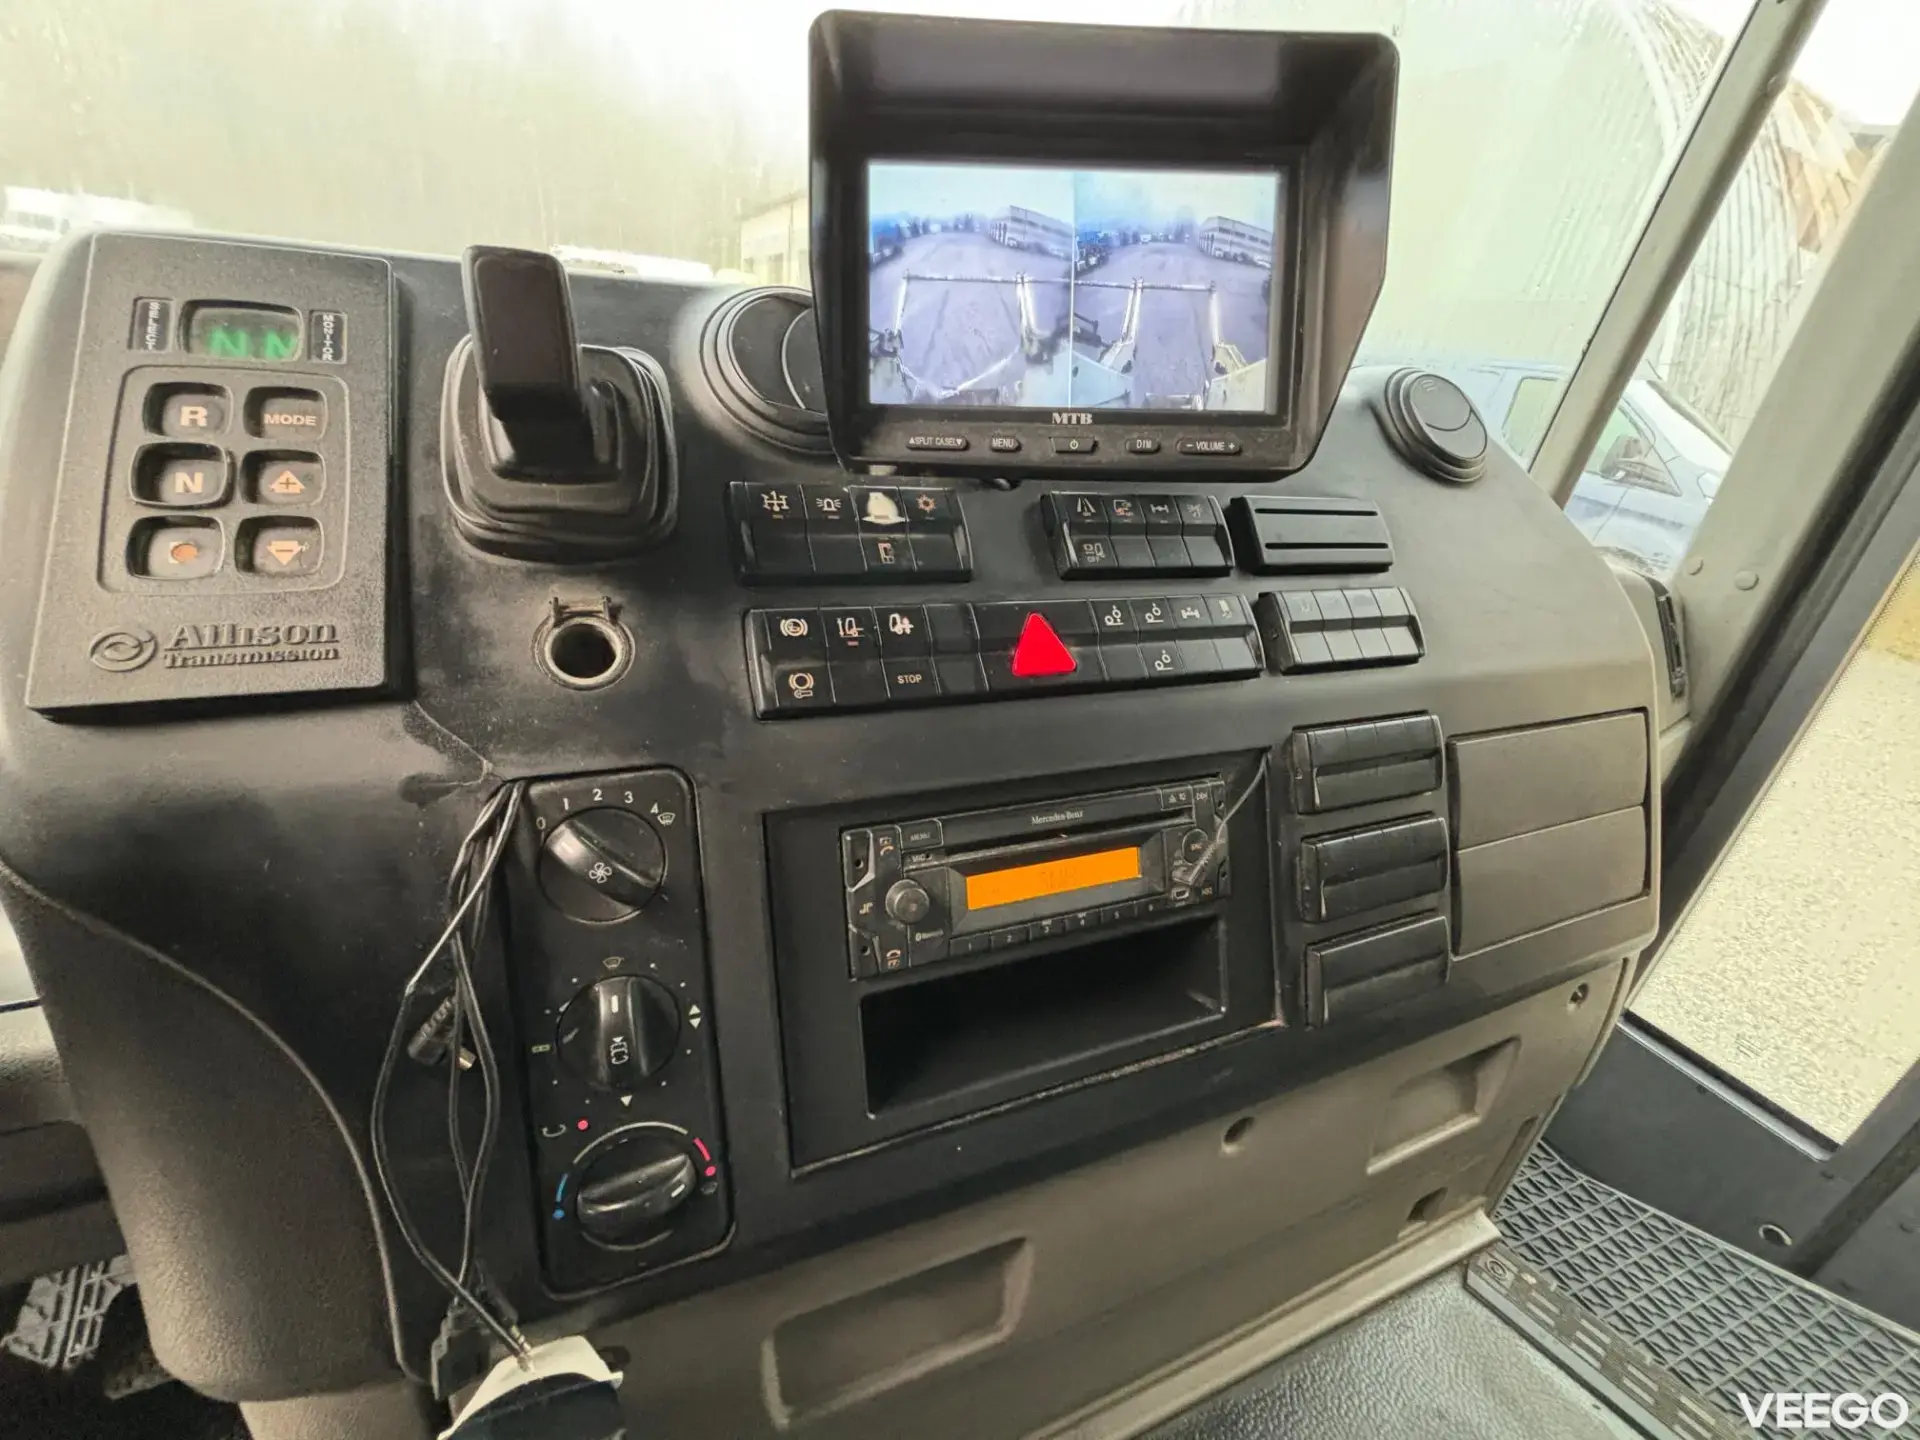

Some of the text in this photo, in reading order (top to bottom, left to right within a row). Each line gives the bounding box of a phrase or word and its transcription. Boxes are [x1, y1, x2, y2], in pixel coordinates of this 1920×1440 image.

[145, 302, 161, 350] SELECT
[210, 328, 297, 359] N N
[322, 313, 335, 361] MONITOR
[180, 405, 208, 427] R
[263, 413, 317, 426] MODE
[1052, 412, 1092, 425] MTB
[992, 438, 1014, 448] MENU
[1136, 439, 1152, 450] DIM
[1196, 441, 1225, 450] VOLUME
[174, 472, 205, 494] N
[167, 623, 339, 651] Allison
[165, 648, 339, 668] Transmission
[897, 675, 922, 684] STOP
[593, 788, 602, 801] 2
[624, 791, 634, 804] 3
[563, 797, 569, 811] 1
[650, 802, 659, 814] 4
[536, 816, 546, 829] 0
